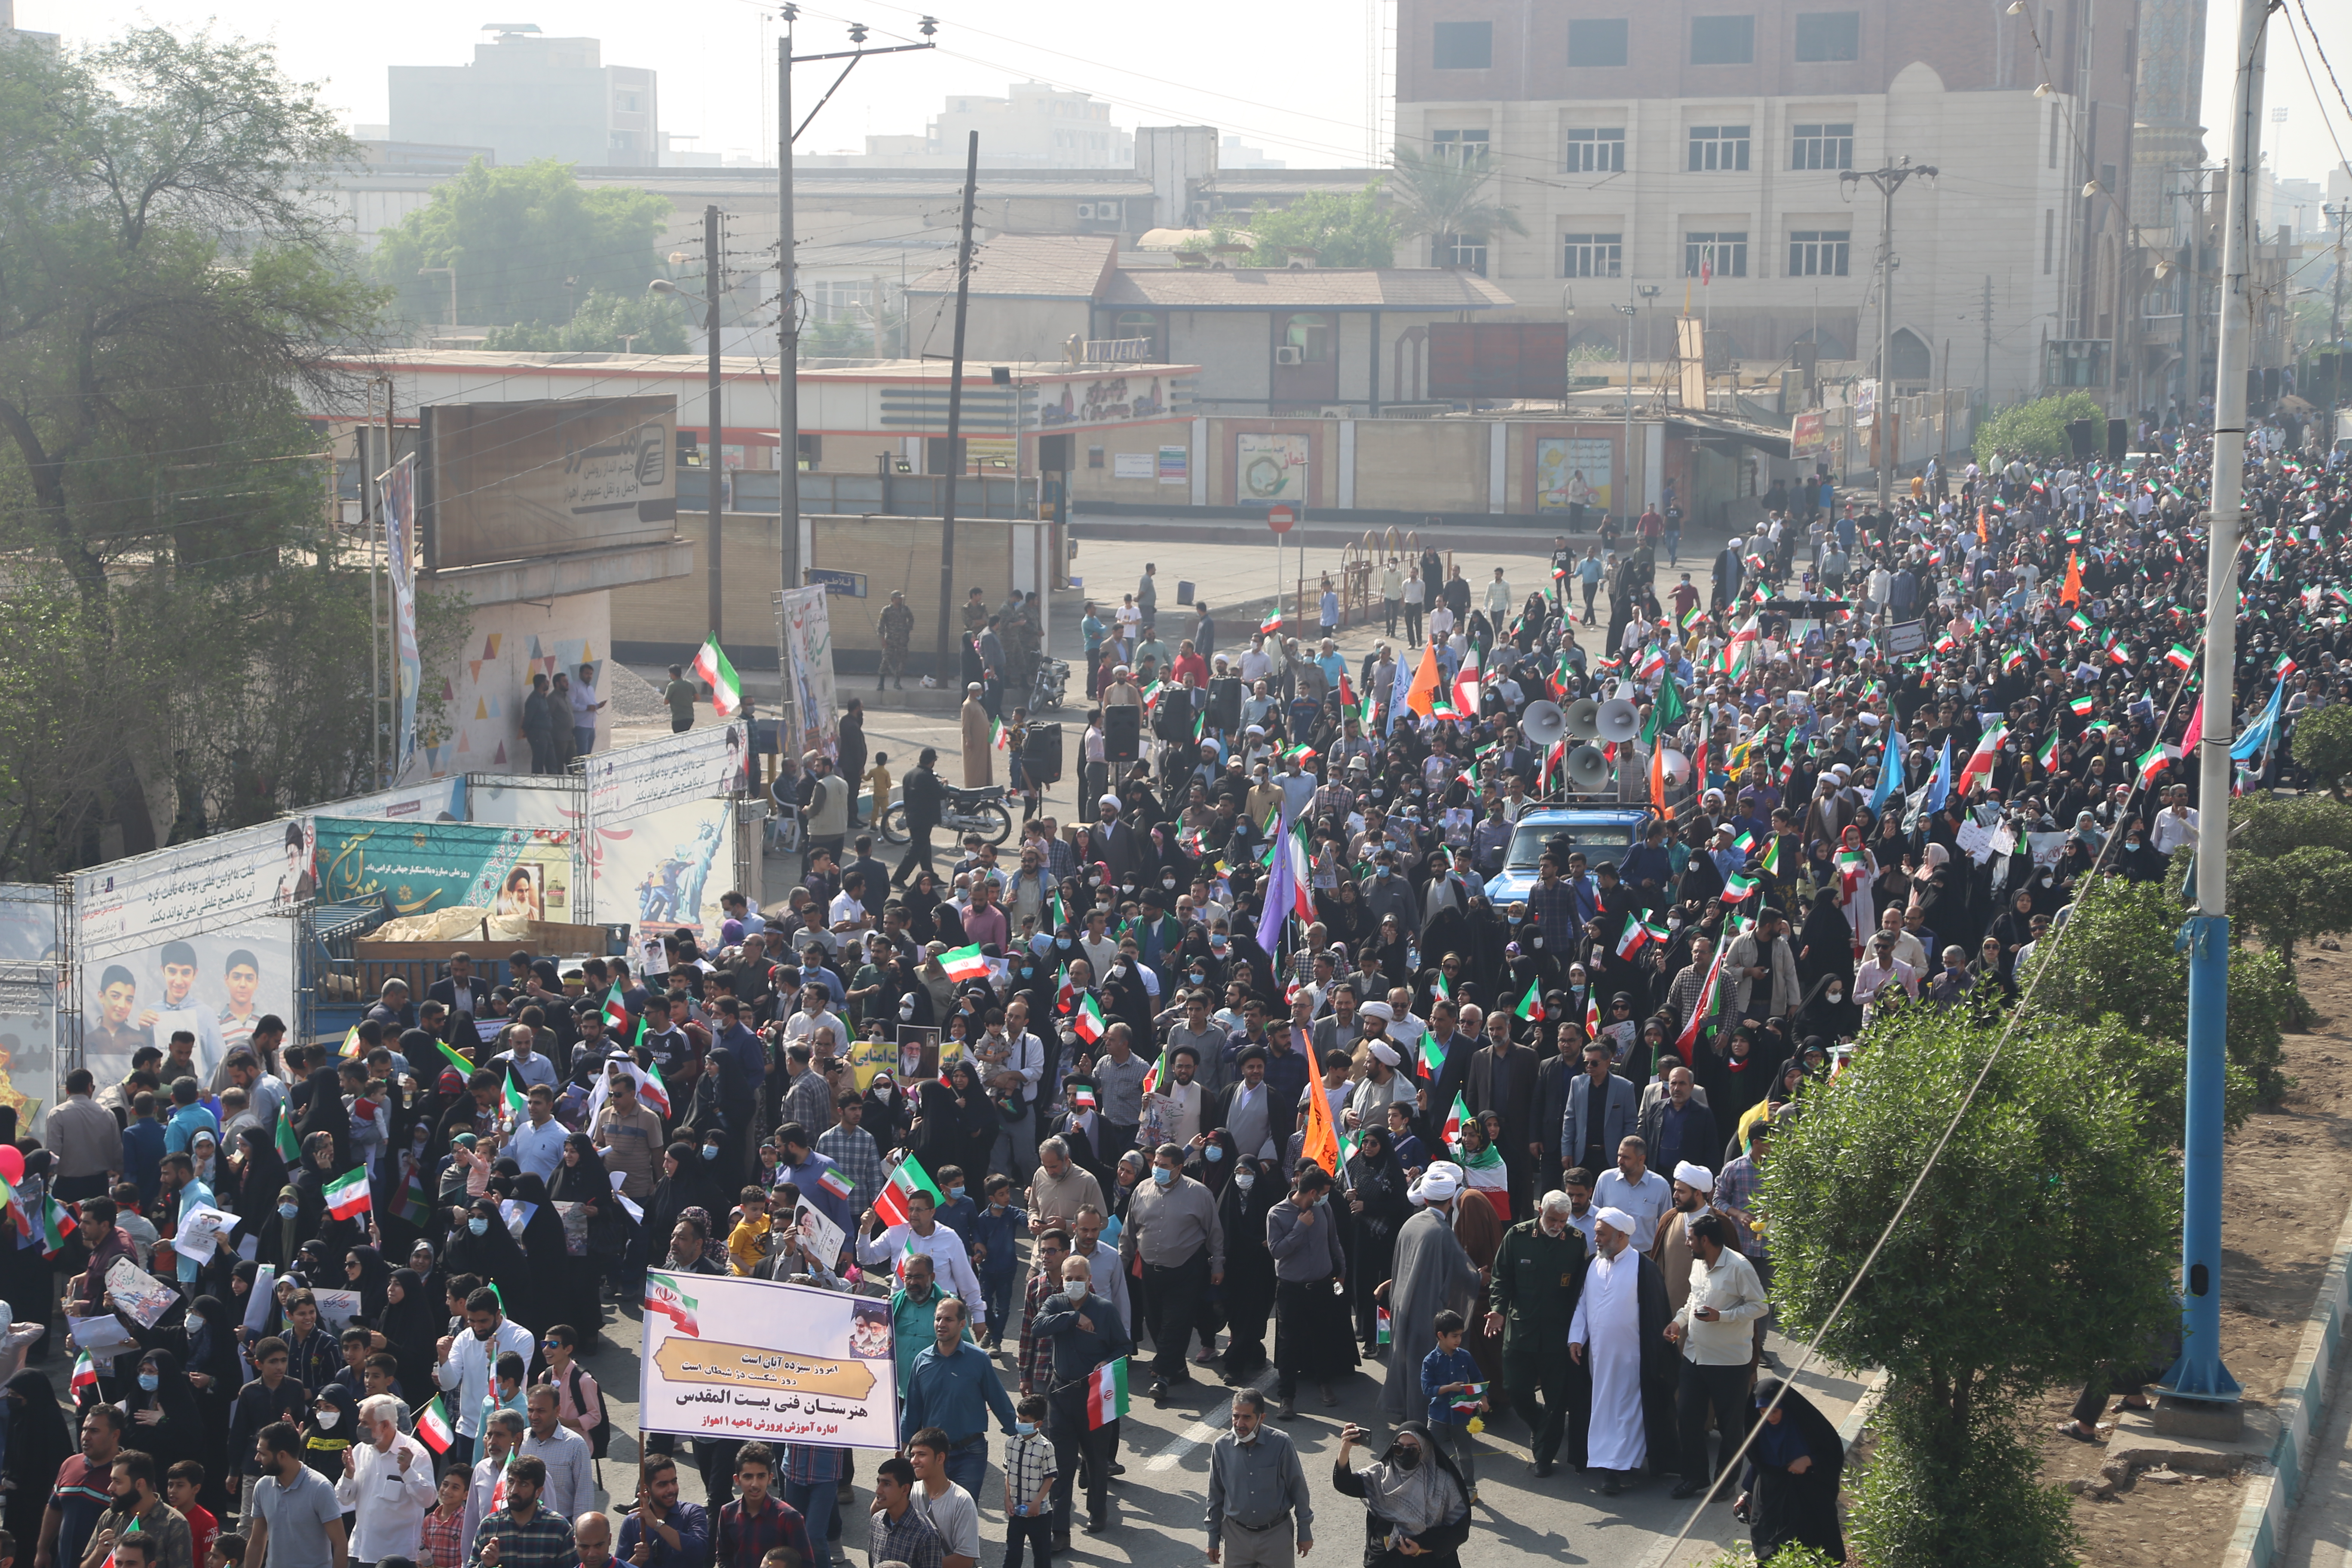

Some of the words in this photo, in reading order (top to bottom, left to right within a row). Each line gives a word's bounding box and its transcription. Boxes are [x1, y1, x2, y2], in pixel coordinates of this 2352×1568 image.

[584, 462, 601, 479] روشن
[603, 459, 616, 478] انداز
[618, 459, 634, 477] چشم
[581, 487, 601, 501] عمومی
[603, 481, 615, 499] نقل
[616, 487, 619, 497] و
[374, 864, 391, 873] گرامی
[391, 864, 408, 874] جهانی
[408, 865, 427, 875] استکبار
[432, 866, 448, 876] مبارزه
[449, 867, 460, 877] ملی
[459, 870, 469, 878] روز
[162, 881, 177, 899] ثابت
[178, 881, 186, 893] که
[187, 882, 199, 895] بود
[236, 881, 255, 903] آمریکا
[147, 887, 160, 906] کرد
[218, 893, 235, 910] هیچ
[197, 895, 217, 916] غلطی
[854, 1048, 888, 1066] امنایی
[741, 1354, 761, 1366] است
[763, 1356, 784, 1370] آبان
[682, 1361, 702, 1372] است
[704, 1365, 732, 1377] شیطان
[784, 1361, 811, 1373] سیزده
[813, 1364, 839, 1375] امروز
[735, 1369, 745, 1380] دژ
[748, 1372, 777, 1383] شکست
[780, 1378, 796, 1386] روز
[676, 1388, 731, 1406] المقدس
[734, 1392, 771, 1412] بیت
[774, 1394, 801, 1415] فنی
[803, 1397, 868, 1420] هنرستان
[701, 1415, 724, 1427] اهواز
[731, 1418, 753, 1429] ناحیه
[754, 1419, 783, 1433] پرورش
[784, 1421, 816, 1434] آموزش
[816, 1424, 839, 1436] اداره
